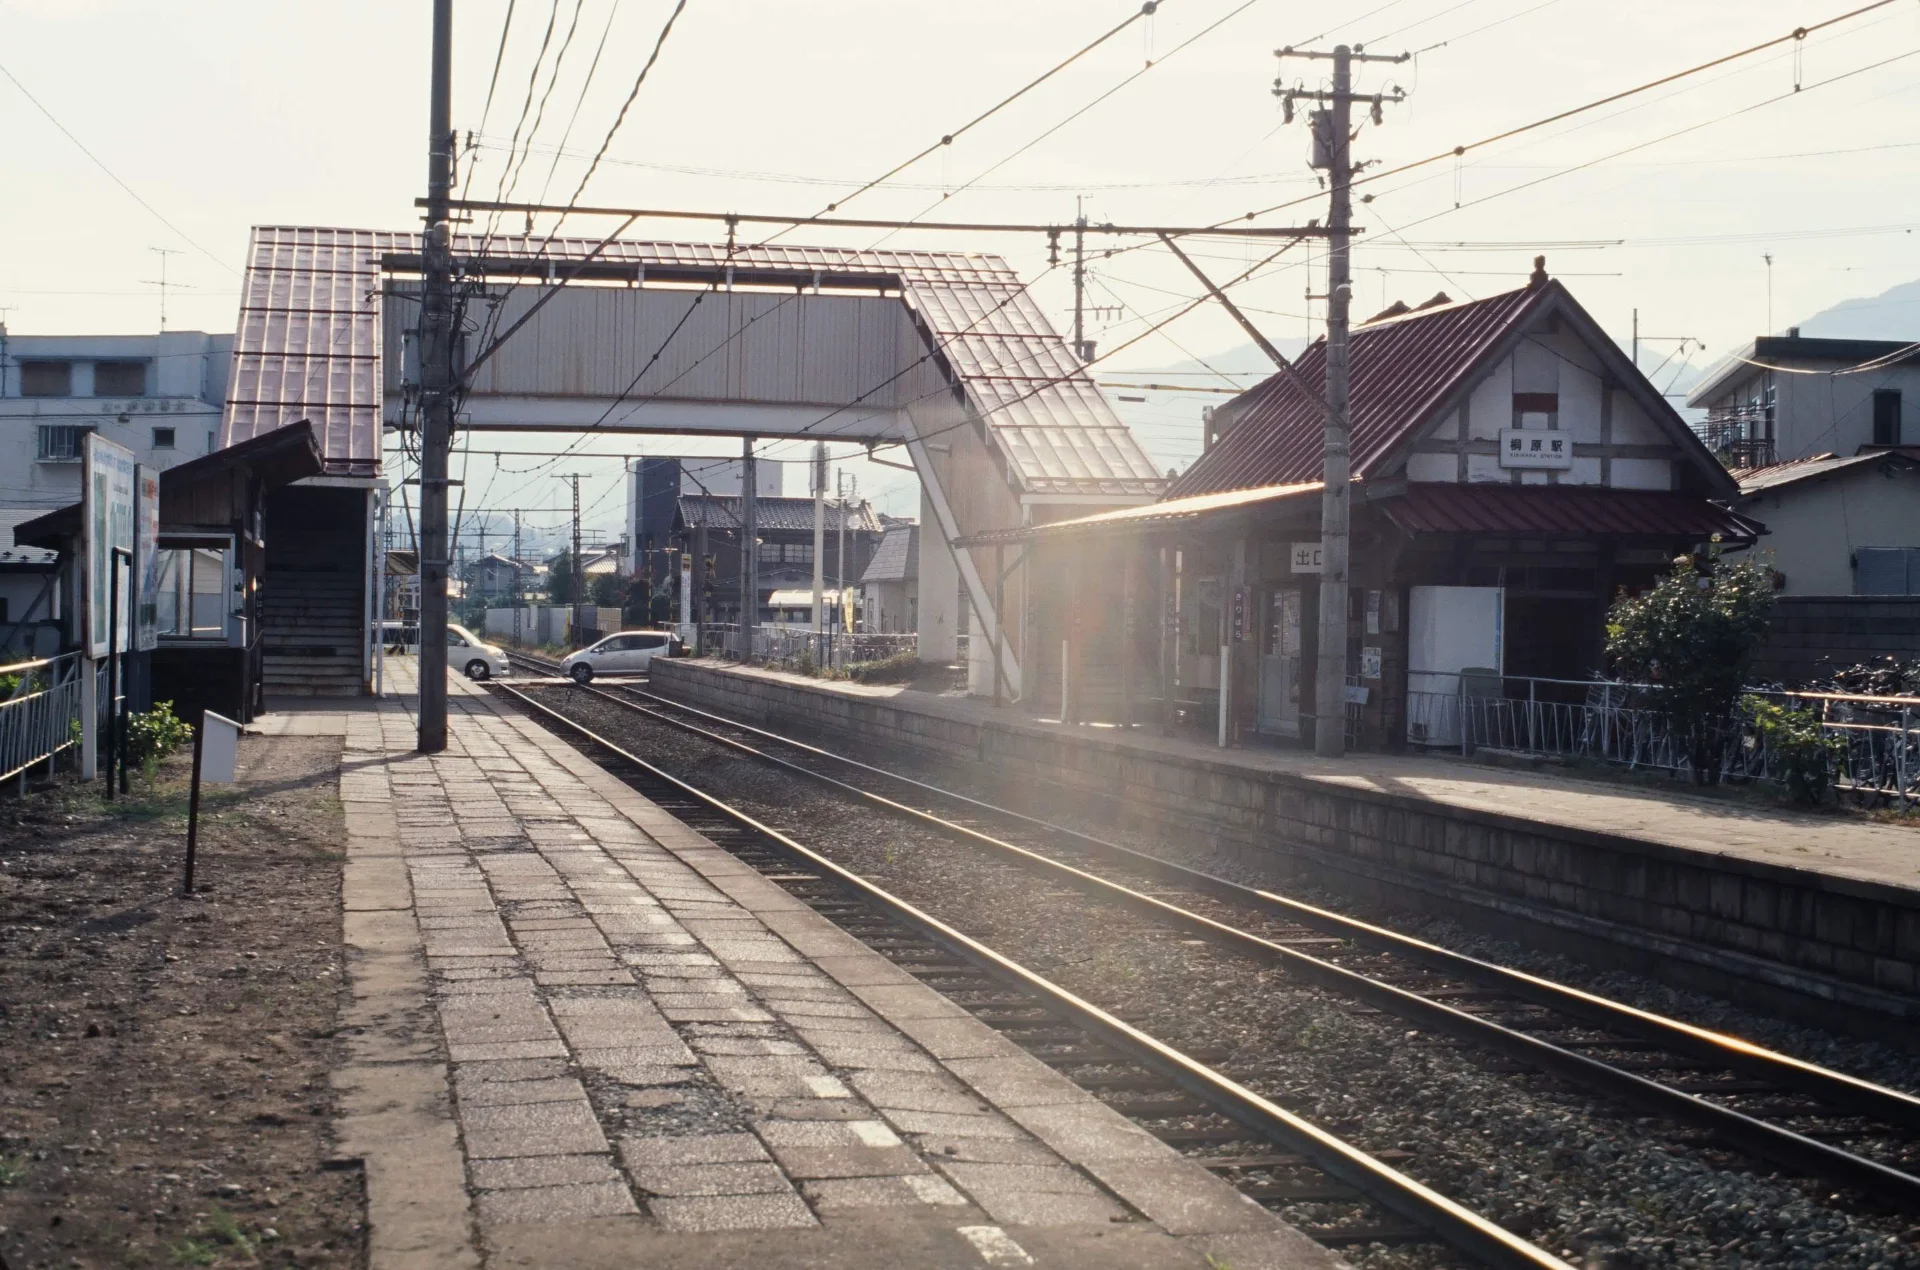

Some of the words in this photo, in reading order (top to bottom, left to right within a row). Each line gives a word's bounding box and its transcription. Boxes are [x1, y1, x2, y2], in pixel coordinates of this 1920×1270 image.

[1510, 438, 1563, 452] 桐原駅
[1296, 549, 1322, 566] 出口
